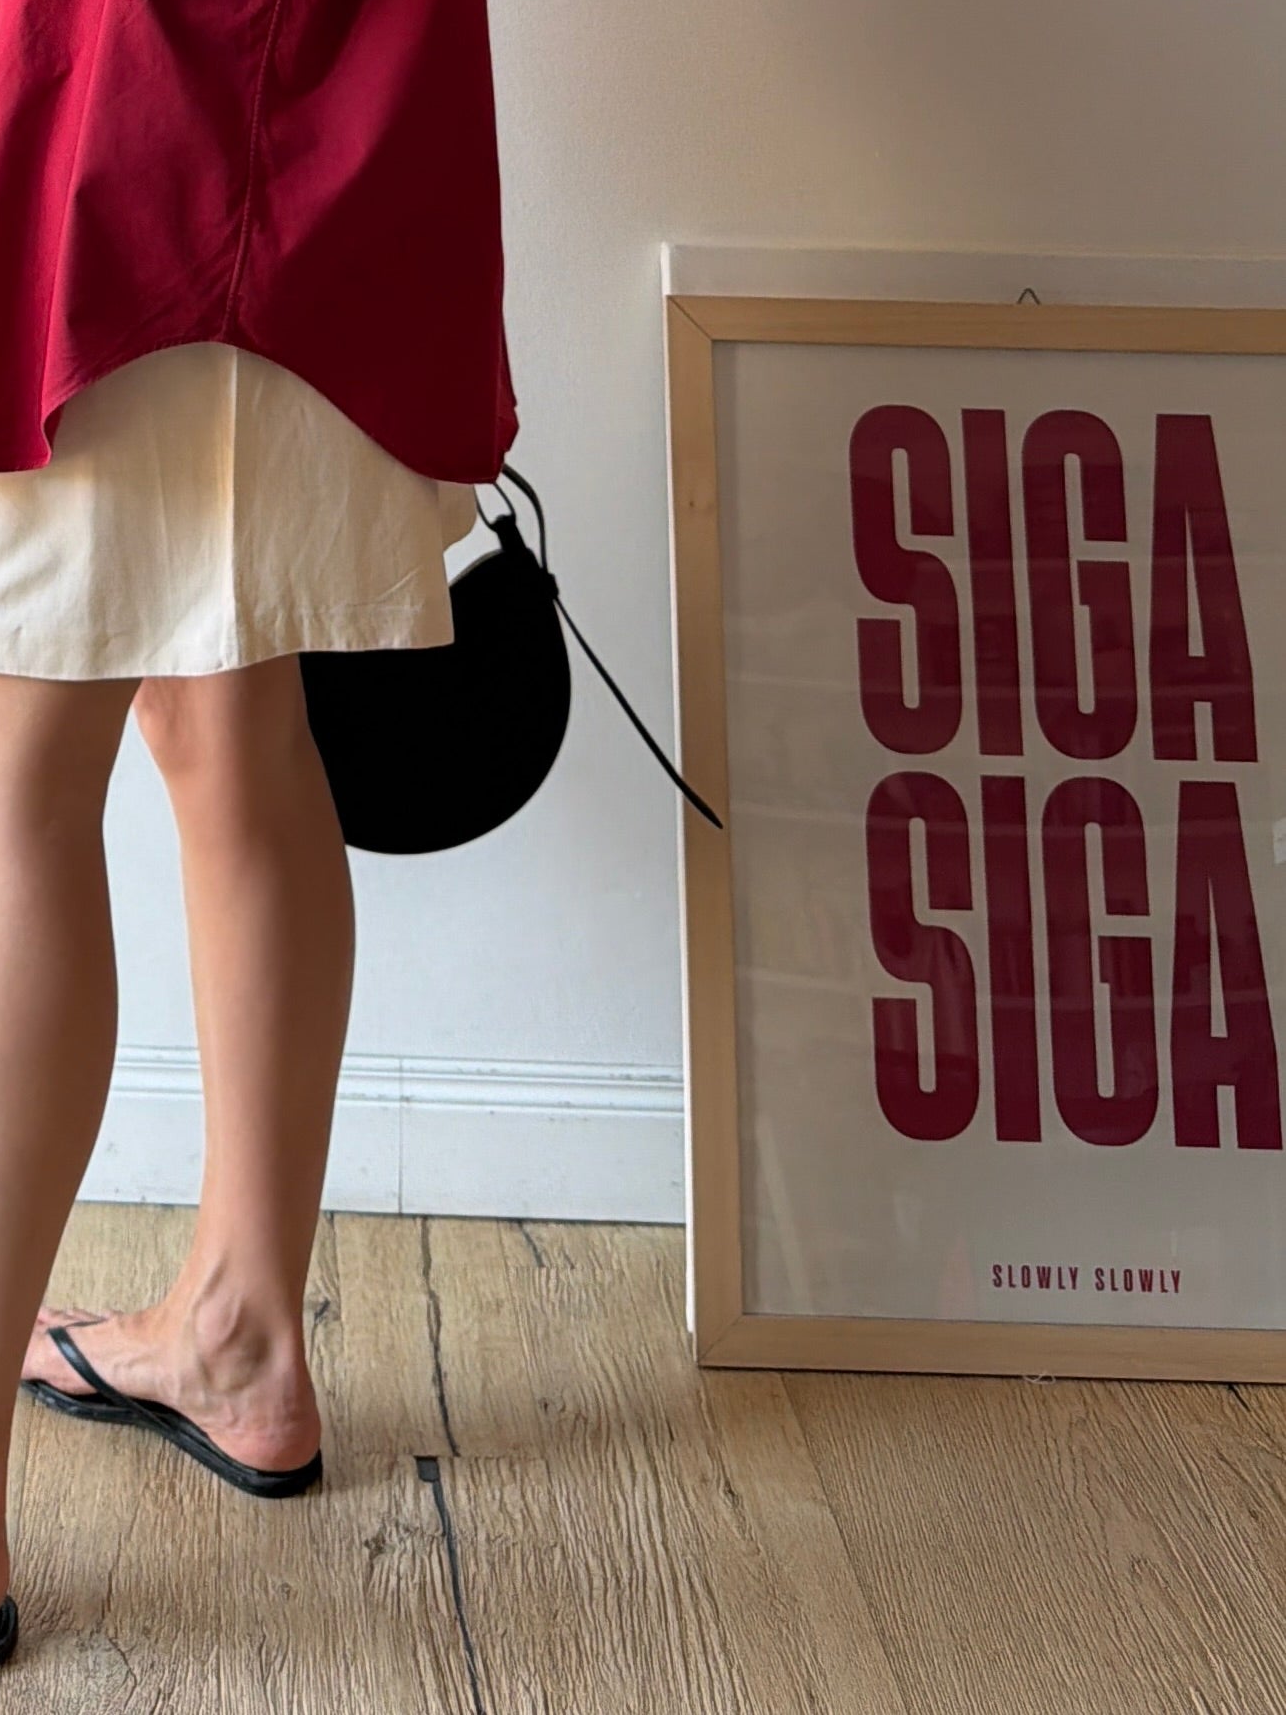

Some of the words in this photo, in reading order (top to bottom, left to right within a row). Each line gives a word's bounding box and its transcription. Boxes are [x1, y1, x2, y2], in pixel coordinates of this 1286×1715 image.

[850, 404, 1258, 763] SIGA
[867, 771, 1283, 1151] SIGA
[992, 1264, 1079, 1290] SLOWLY
[1094, 1267, 1181, 1293] SLOWLY
